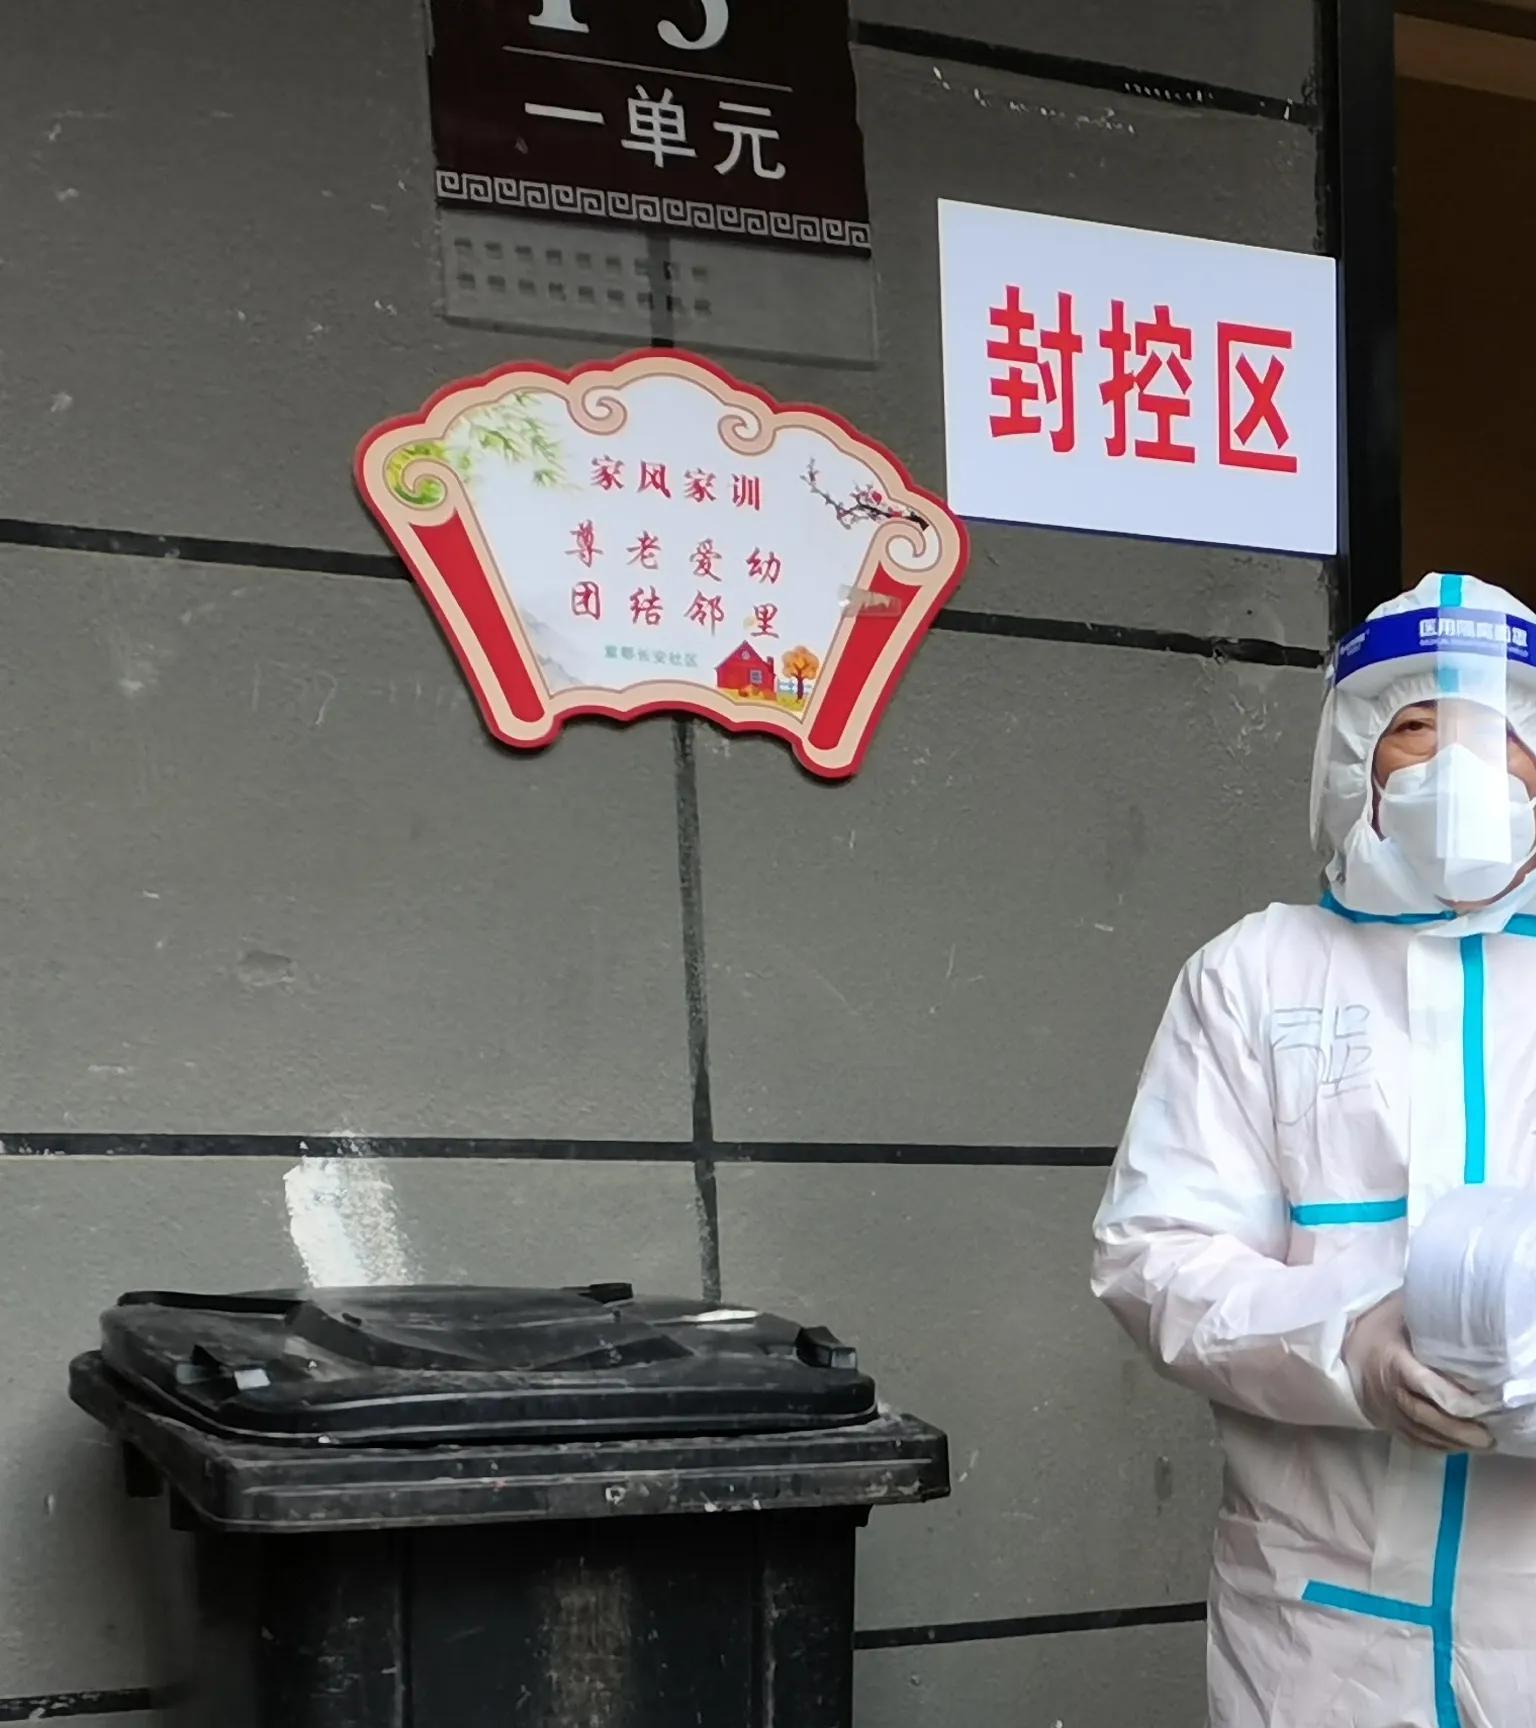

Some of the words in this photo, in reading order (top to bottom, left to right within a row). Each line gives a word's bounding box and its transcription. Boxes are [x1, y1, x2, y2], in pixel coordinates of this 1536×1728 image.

[524, 84, 788, 180] 一单元
[986, 284, 1298, 474] 封控区
[590, 454, 761, 512] 家风家训
[564, 518, 782, 584] 尊老爱幼
[571, 580, 780, 640] 团结邻里
